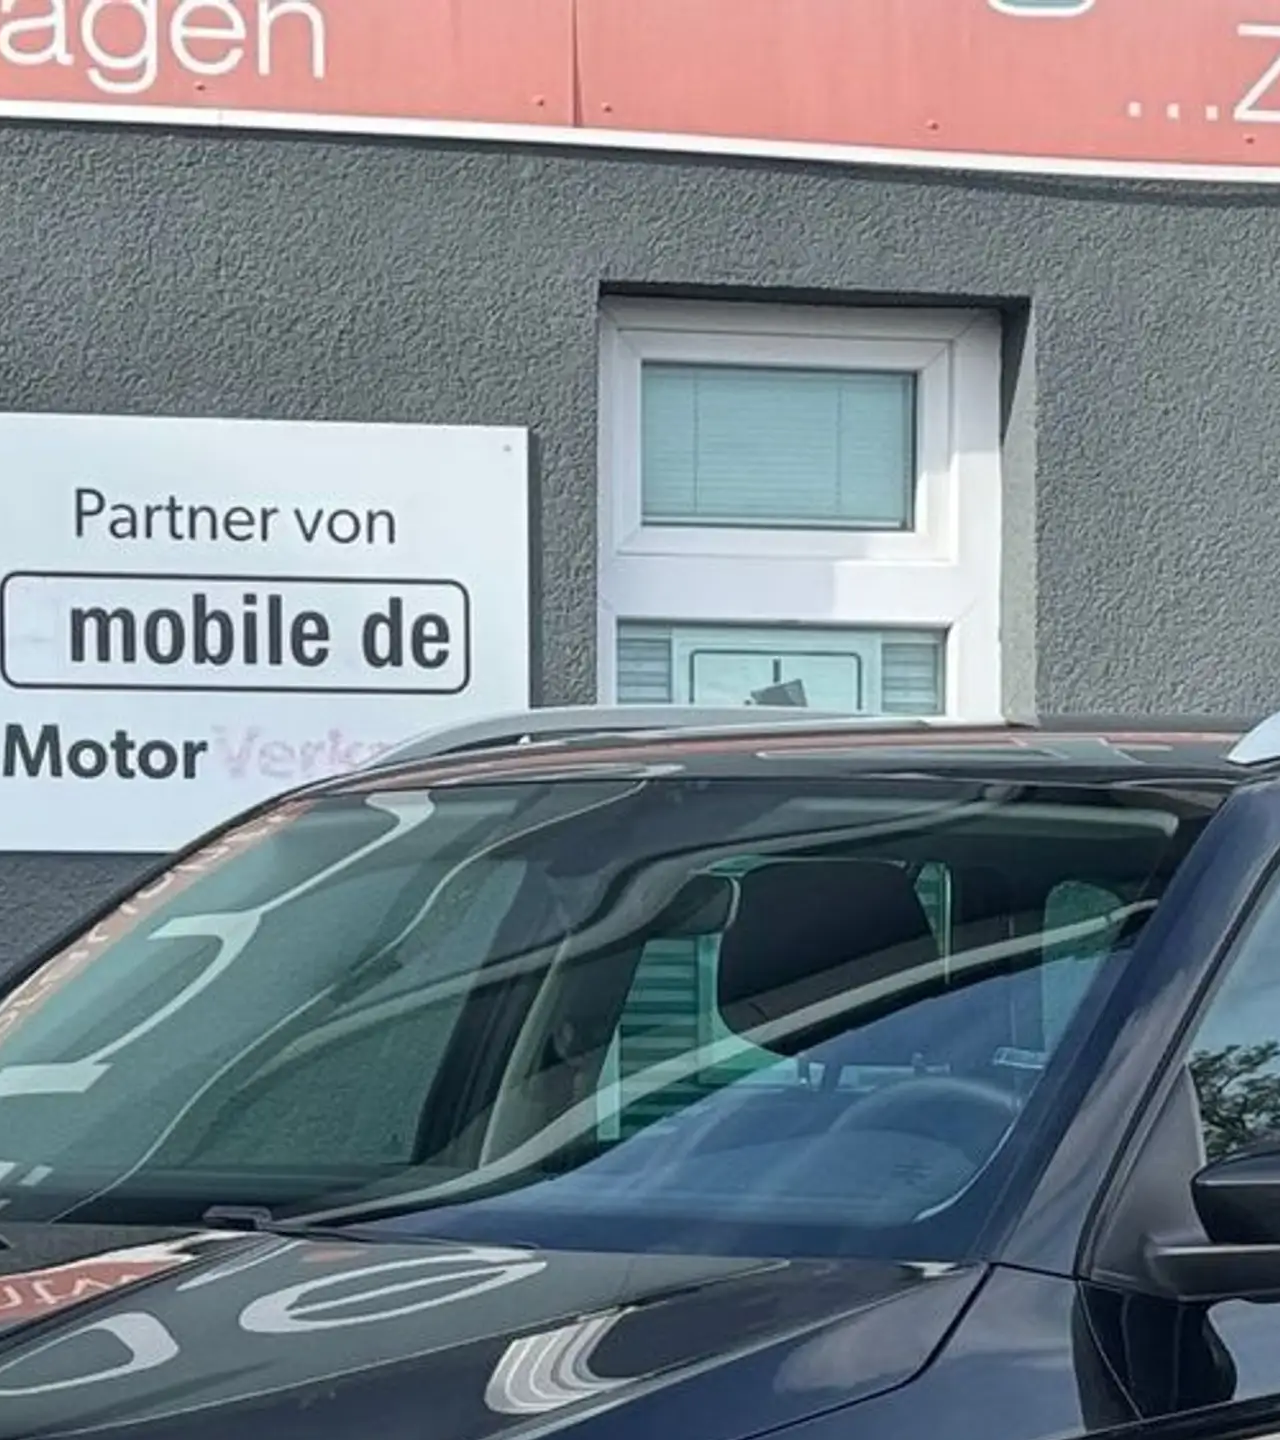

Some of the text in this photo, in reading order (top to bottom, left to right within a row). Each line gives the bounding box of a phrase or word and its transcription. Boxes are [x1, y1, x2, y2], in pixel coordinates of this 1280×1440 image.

[73, 487, 396, 544] Partner von
[70, 593, 451, 669] mobile de
[2, 723, 208, 779] Motor
